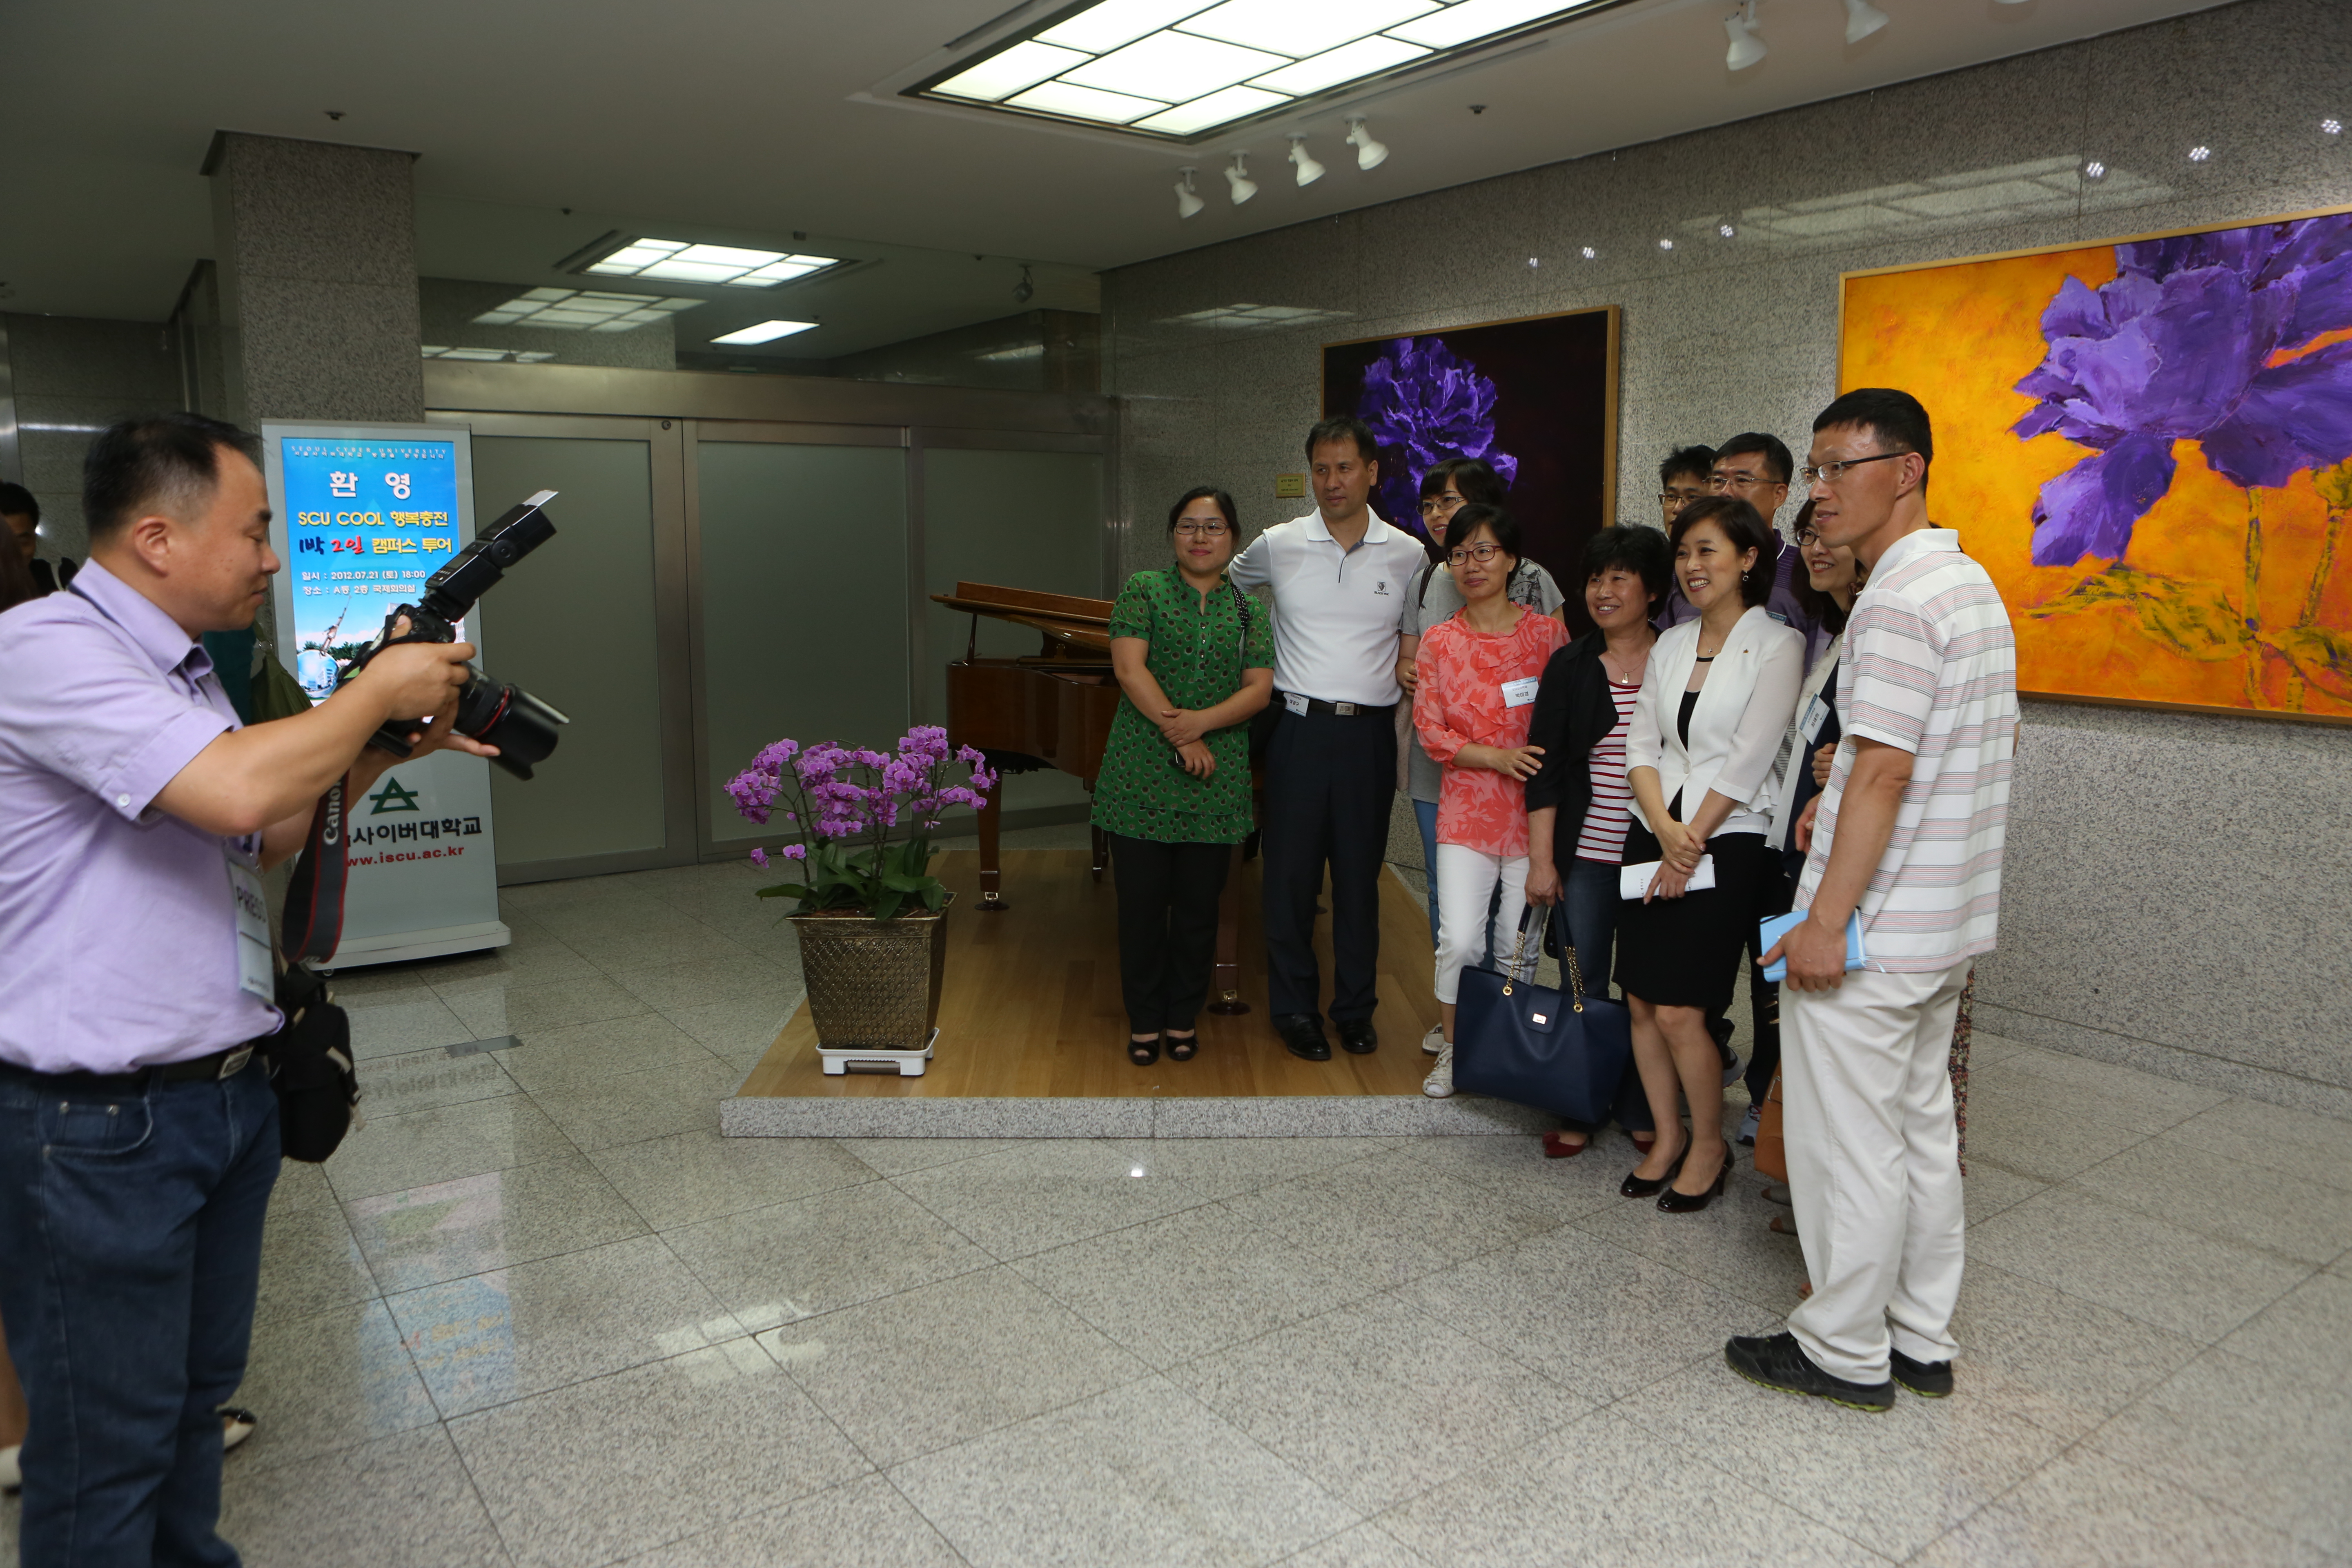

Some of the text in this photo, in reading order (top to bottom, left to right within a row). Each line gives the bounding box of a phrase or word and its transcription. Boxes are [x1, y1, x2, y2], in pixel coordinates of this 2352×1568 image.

[330, 471, 411, 500] 환 영
[298, 511, 449, 527] SCU COOL 행복충전
[299, 535, 452, 555] 1박 2일 캠퍼스 투어
[302, 572, 321, 581] 일시
[331, 571, 379, 580] 2012.07.21
[382, 570, 398, 580] (토)
[402, 570, 426, 579] 18:00
[303, 586, 322, 596] 장소
[373, 584, 416, 594] 국제회의실
[324, 781, 341, 845] Cano
[347, 817, 482, 847] 사이버대학교
